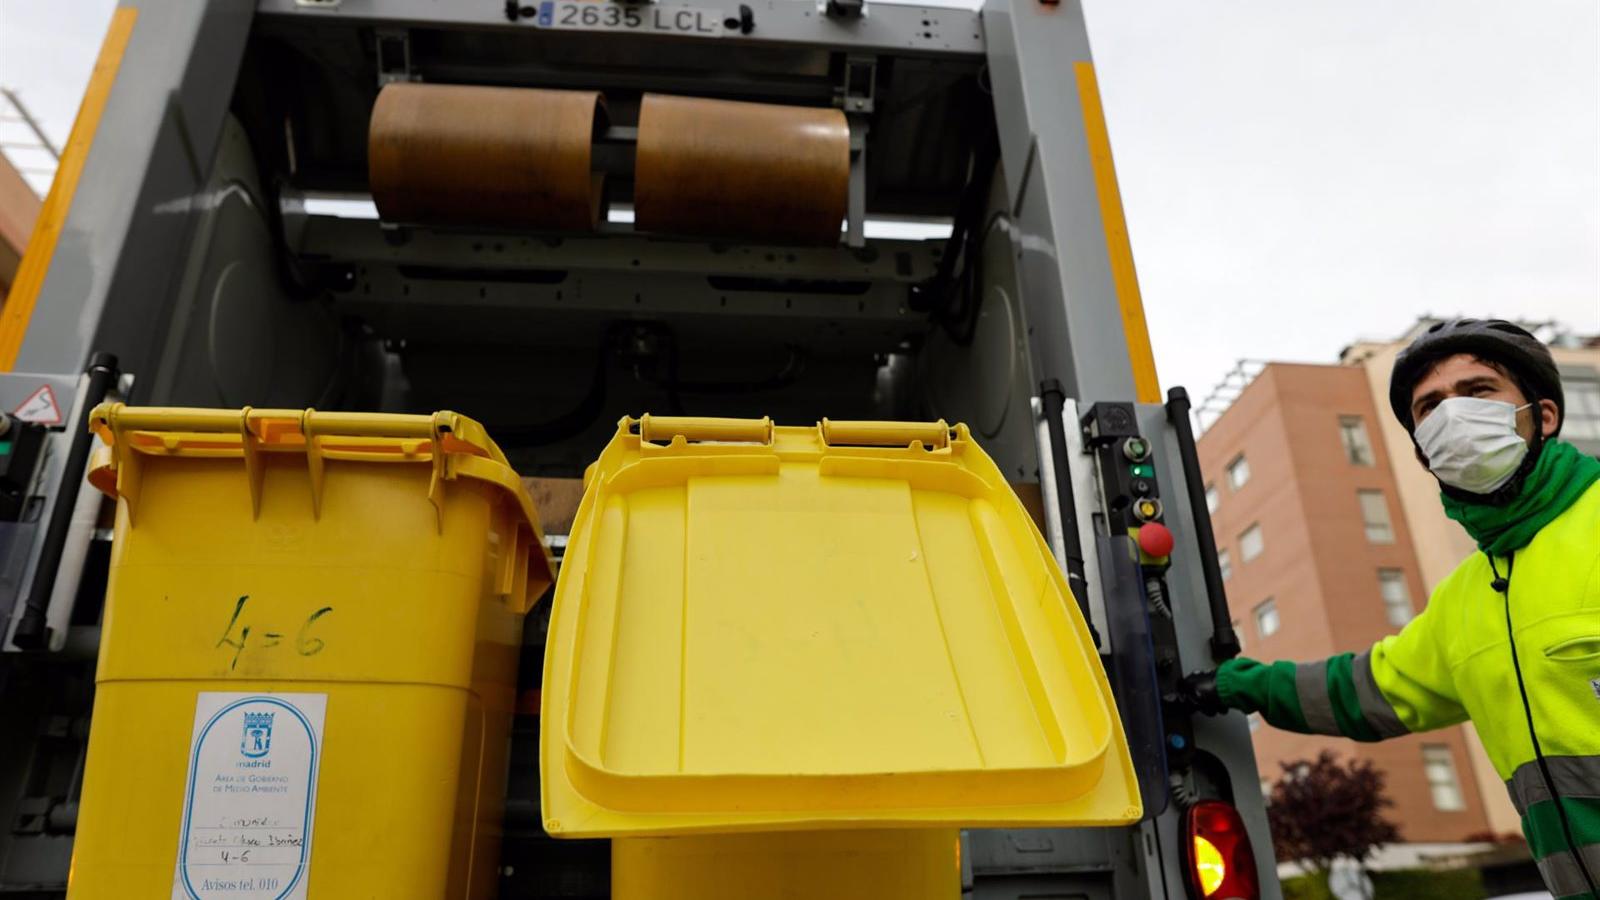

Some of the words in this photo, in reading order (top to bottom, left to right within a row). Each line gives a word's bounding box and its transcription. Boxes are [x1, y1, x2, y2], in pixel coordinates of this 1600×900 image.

[560, 4, 641, 28] 2635
[653, 9, 713, 33] LCL
[236, 760, 271, 768] madrid
[221, 849, 251, 864] 4-6
[201, 878, 237, 891] Avisos
[259, 878, 279, 890] 010
